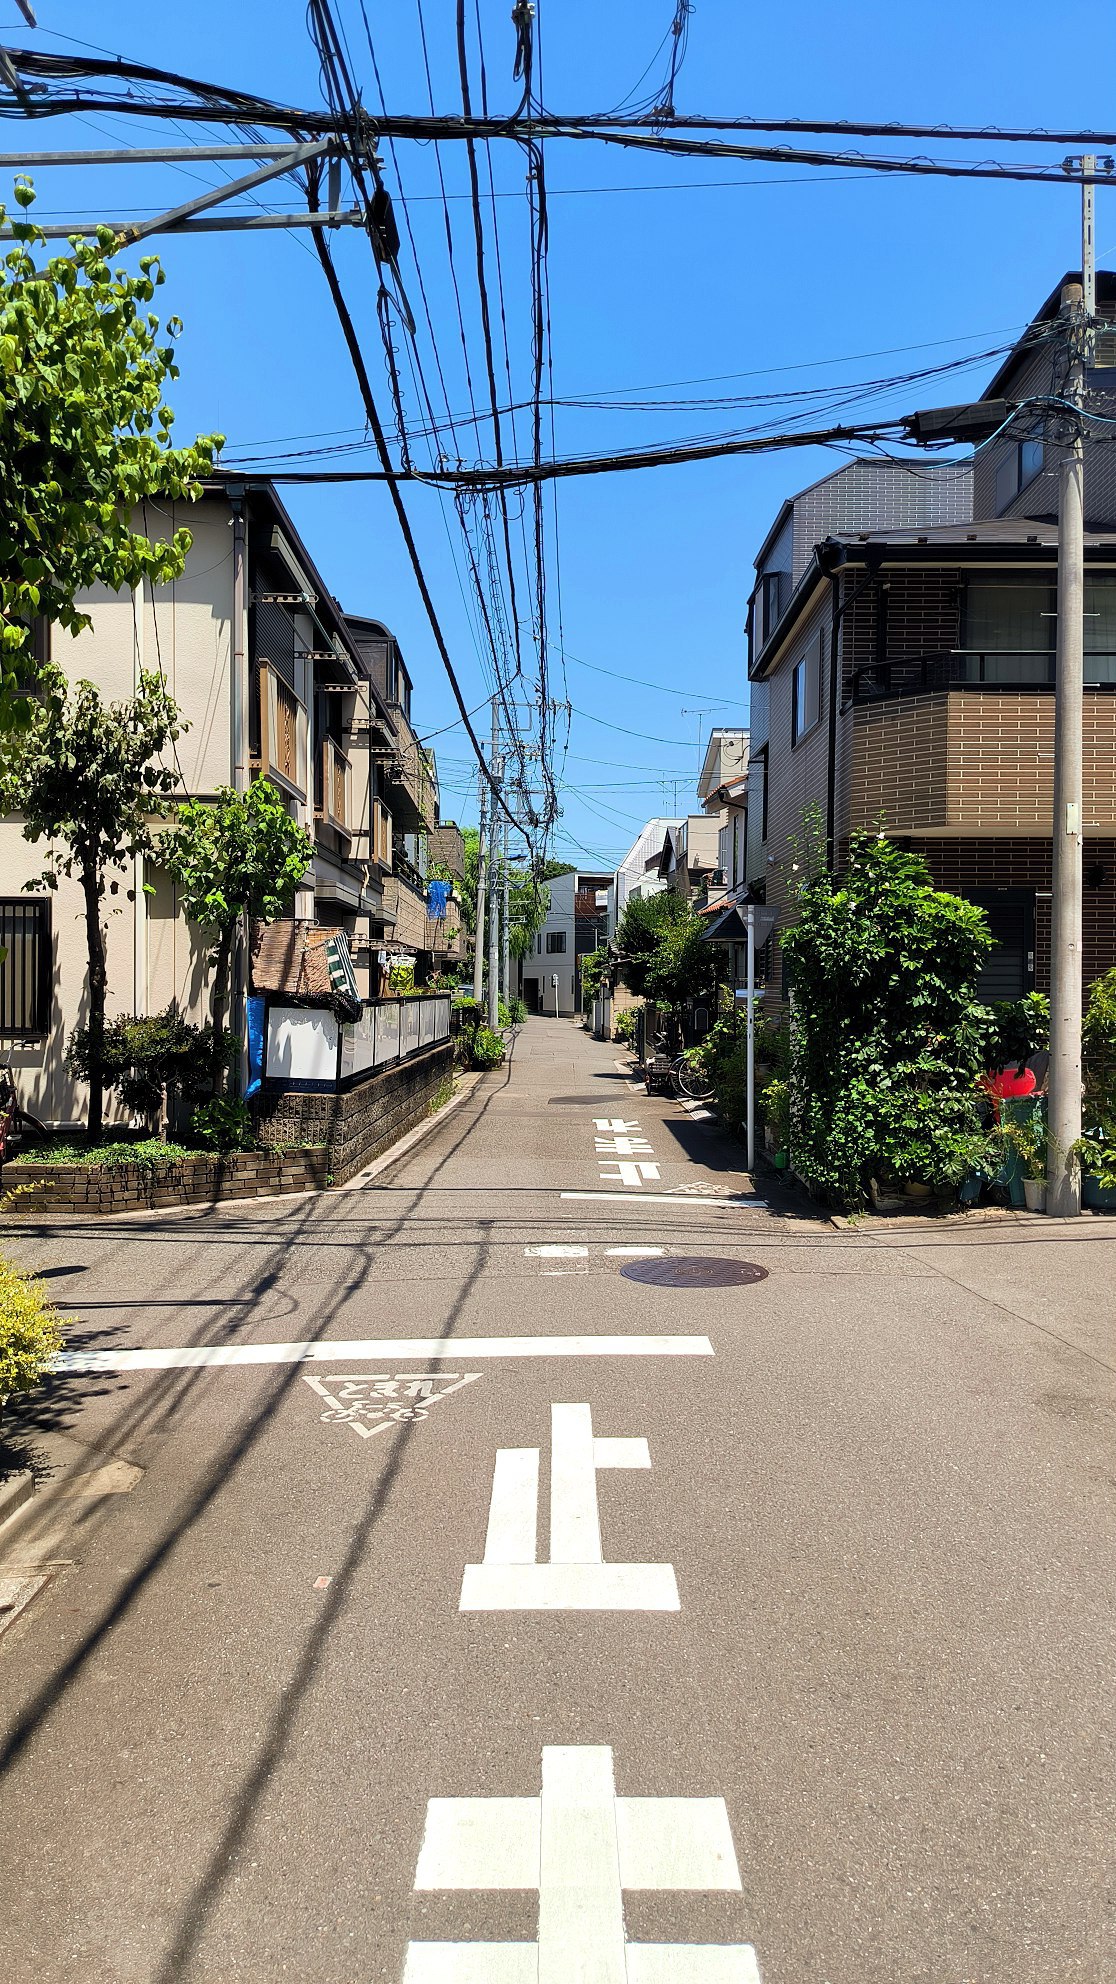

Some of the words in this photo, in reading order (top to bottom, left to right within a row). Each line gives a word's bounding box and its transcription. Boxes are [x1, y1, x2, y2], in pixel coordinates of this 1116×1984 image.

[592, 1118, 662, 1187] 止まれ
[338, 1380, 434, 1398] とまれ
